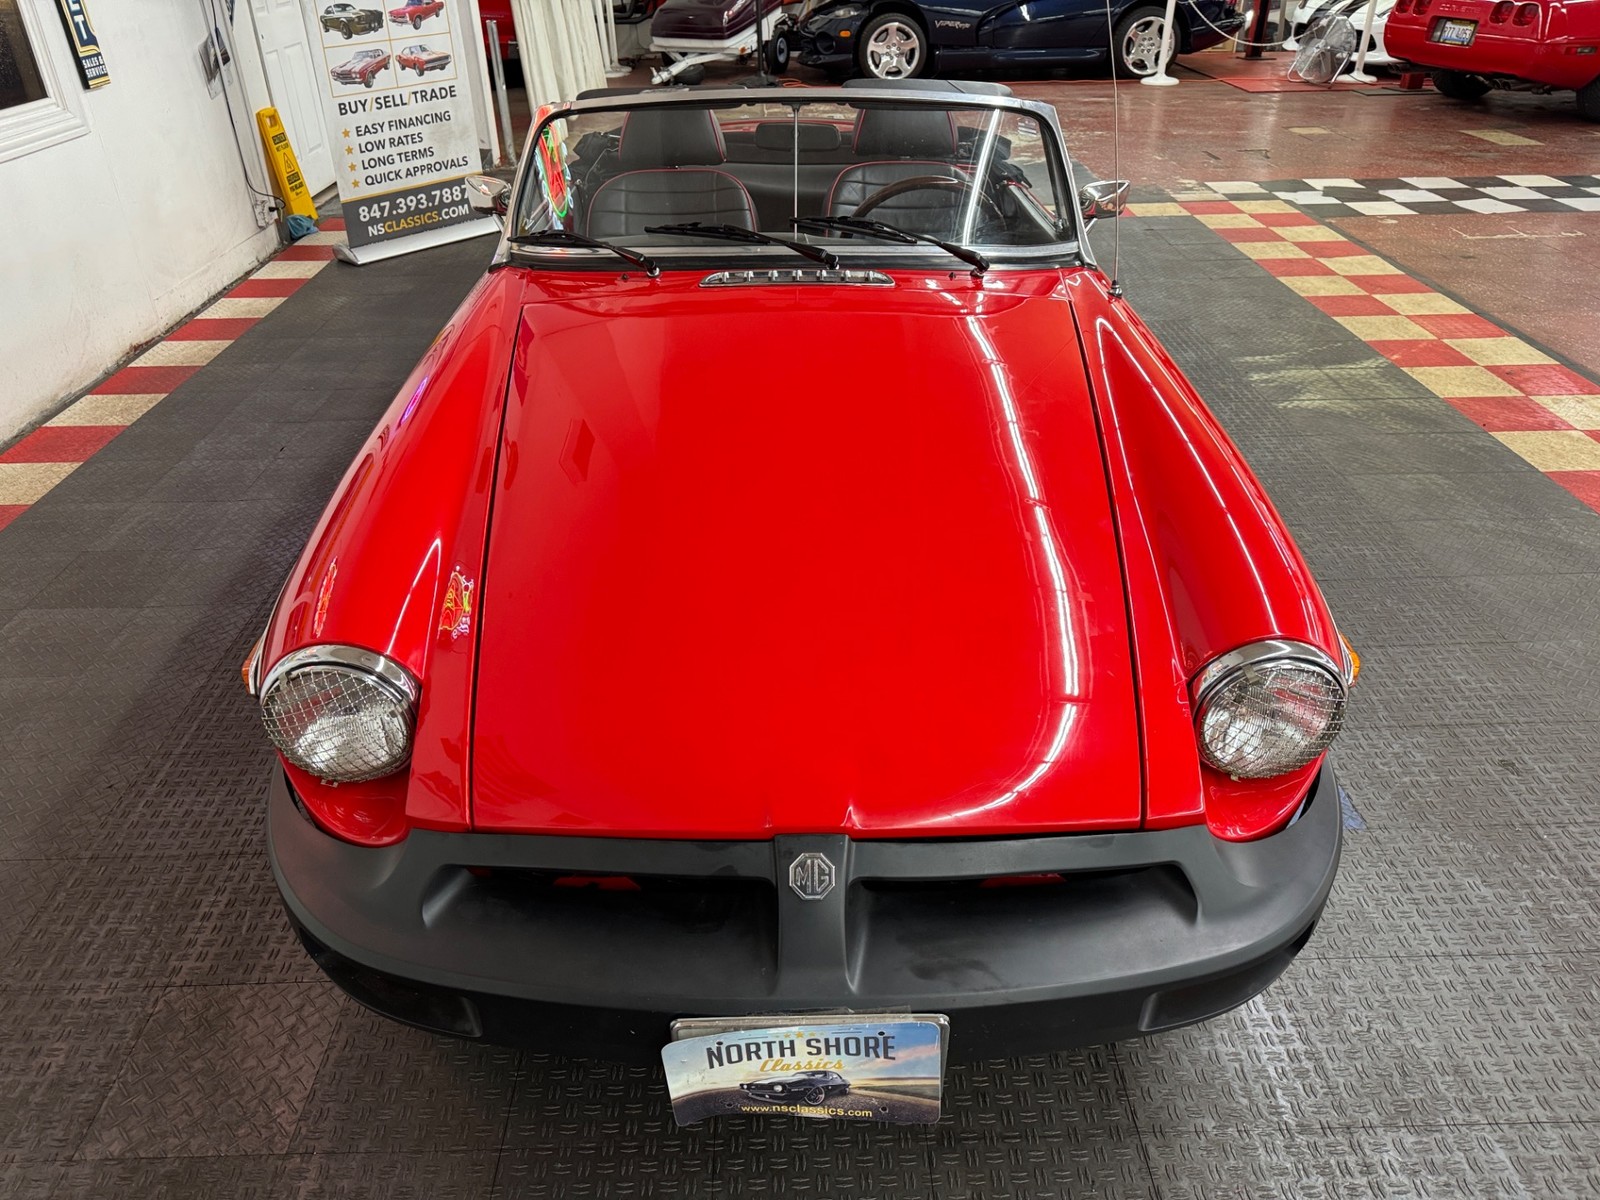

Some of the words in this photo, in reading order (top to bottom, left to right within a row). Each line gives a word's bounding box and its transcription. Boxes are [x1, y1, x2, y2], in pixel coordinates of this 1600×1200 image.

[82, 56, 98, 68] SALES
[85, 65, 107, 78] SERVICE
[338, 85, 457, 116] BUY/SELL/TRADE
[355, 121, 385, 137] EASY
[388, 110, 451, 132] FINANCING
[358, 139, 386, 154] LOW
[389, 132, 423, 148] RATES
[361, 154, 395, 170] LONG
[397, 146, 434, 163] TERMS
[364, 169, 402, 186] QUICK
[405, 156, 469, 179] APPROVALS
[358, 184, 468, 222] 847.393.7887
[367, 204, 470, 237] NSCLASSICS.COM
[795, 859, 829, 893] MG
[706, 1040, 796, 1069] NORTH
[806, 1036, 896, 1060] SHORE
[759, 1058, 845, 1073] Classics
[740, 1103, 873, 1118] www.nsclassics.com
